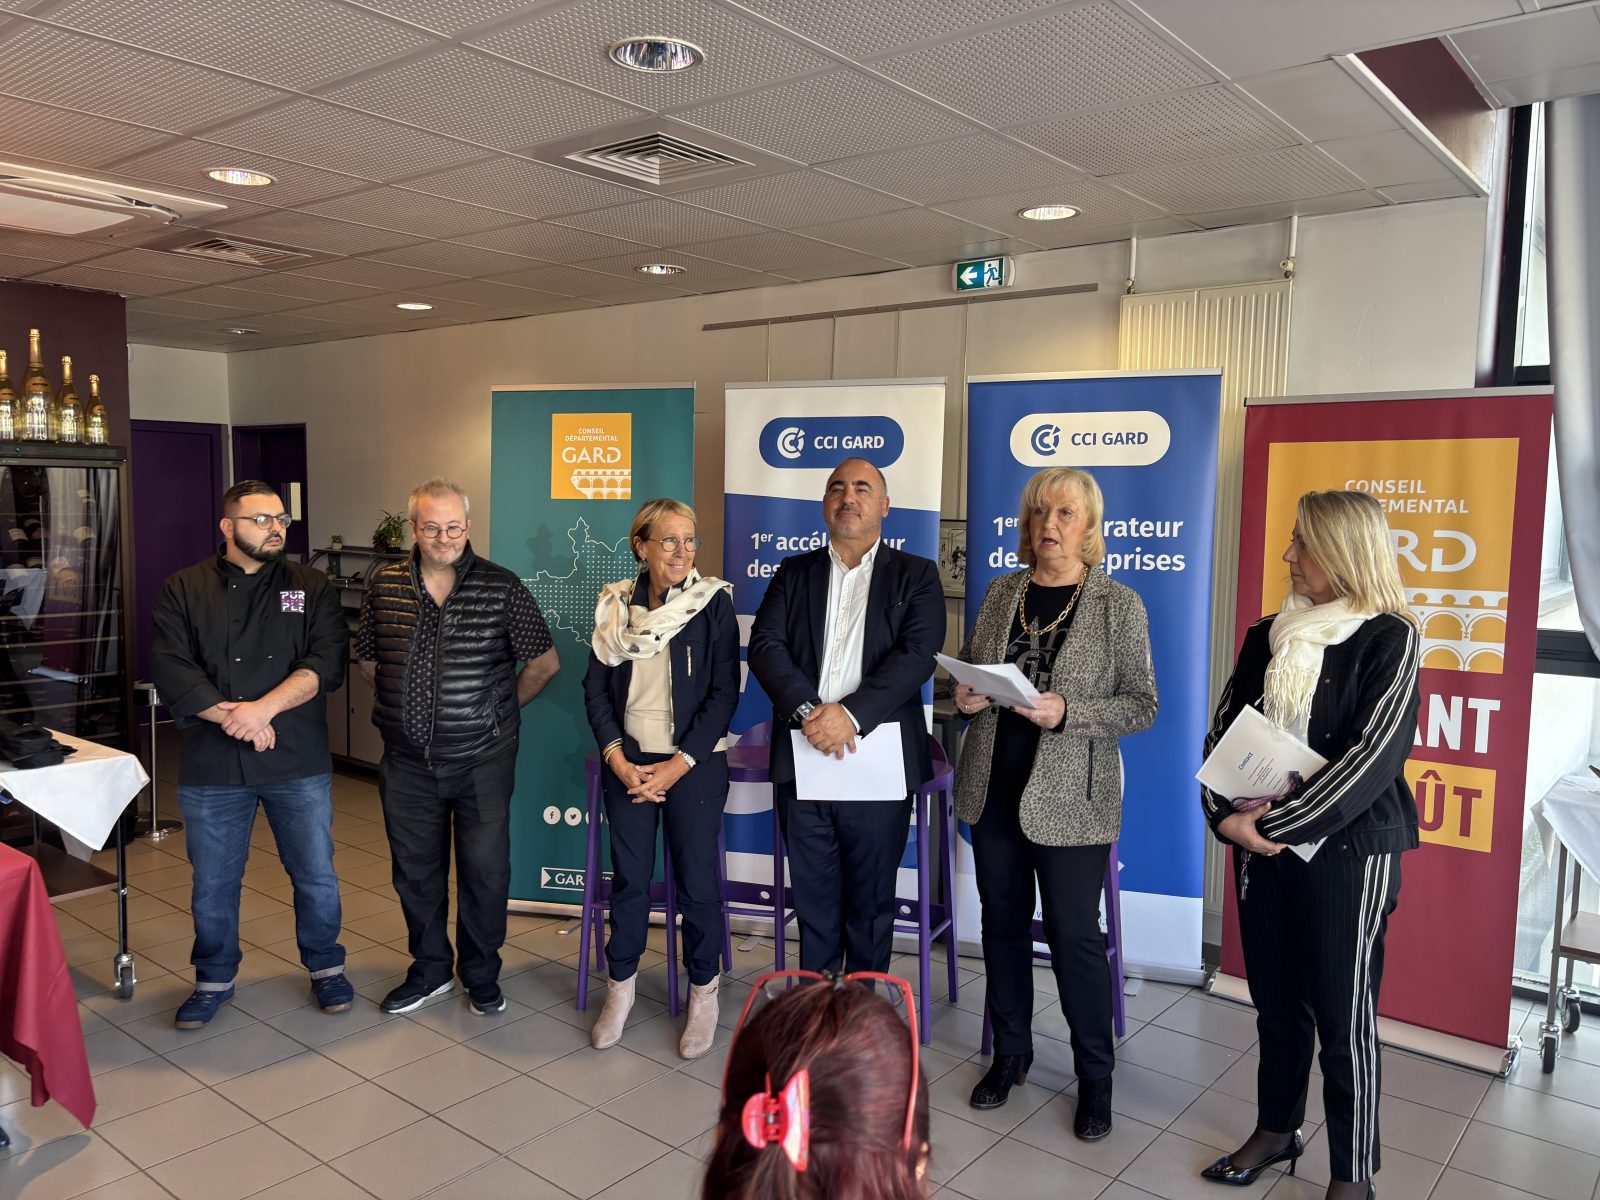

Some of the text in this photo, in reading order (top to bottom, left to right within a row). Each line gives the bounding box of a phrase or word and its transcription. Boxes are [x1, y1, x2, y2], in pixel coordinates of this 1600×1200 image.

[813, 435, 885, 450] CCI GARD
[1071, 431, 1149, 446] CCI GARD
[561, 446, 622, 464] GARD
[1344, 479, 1426, 494] CONSEIL
[1390, 529, 1477, 573] RD
